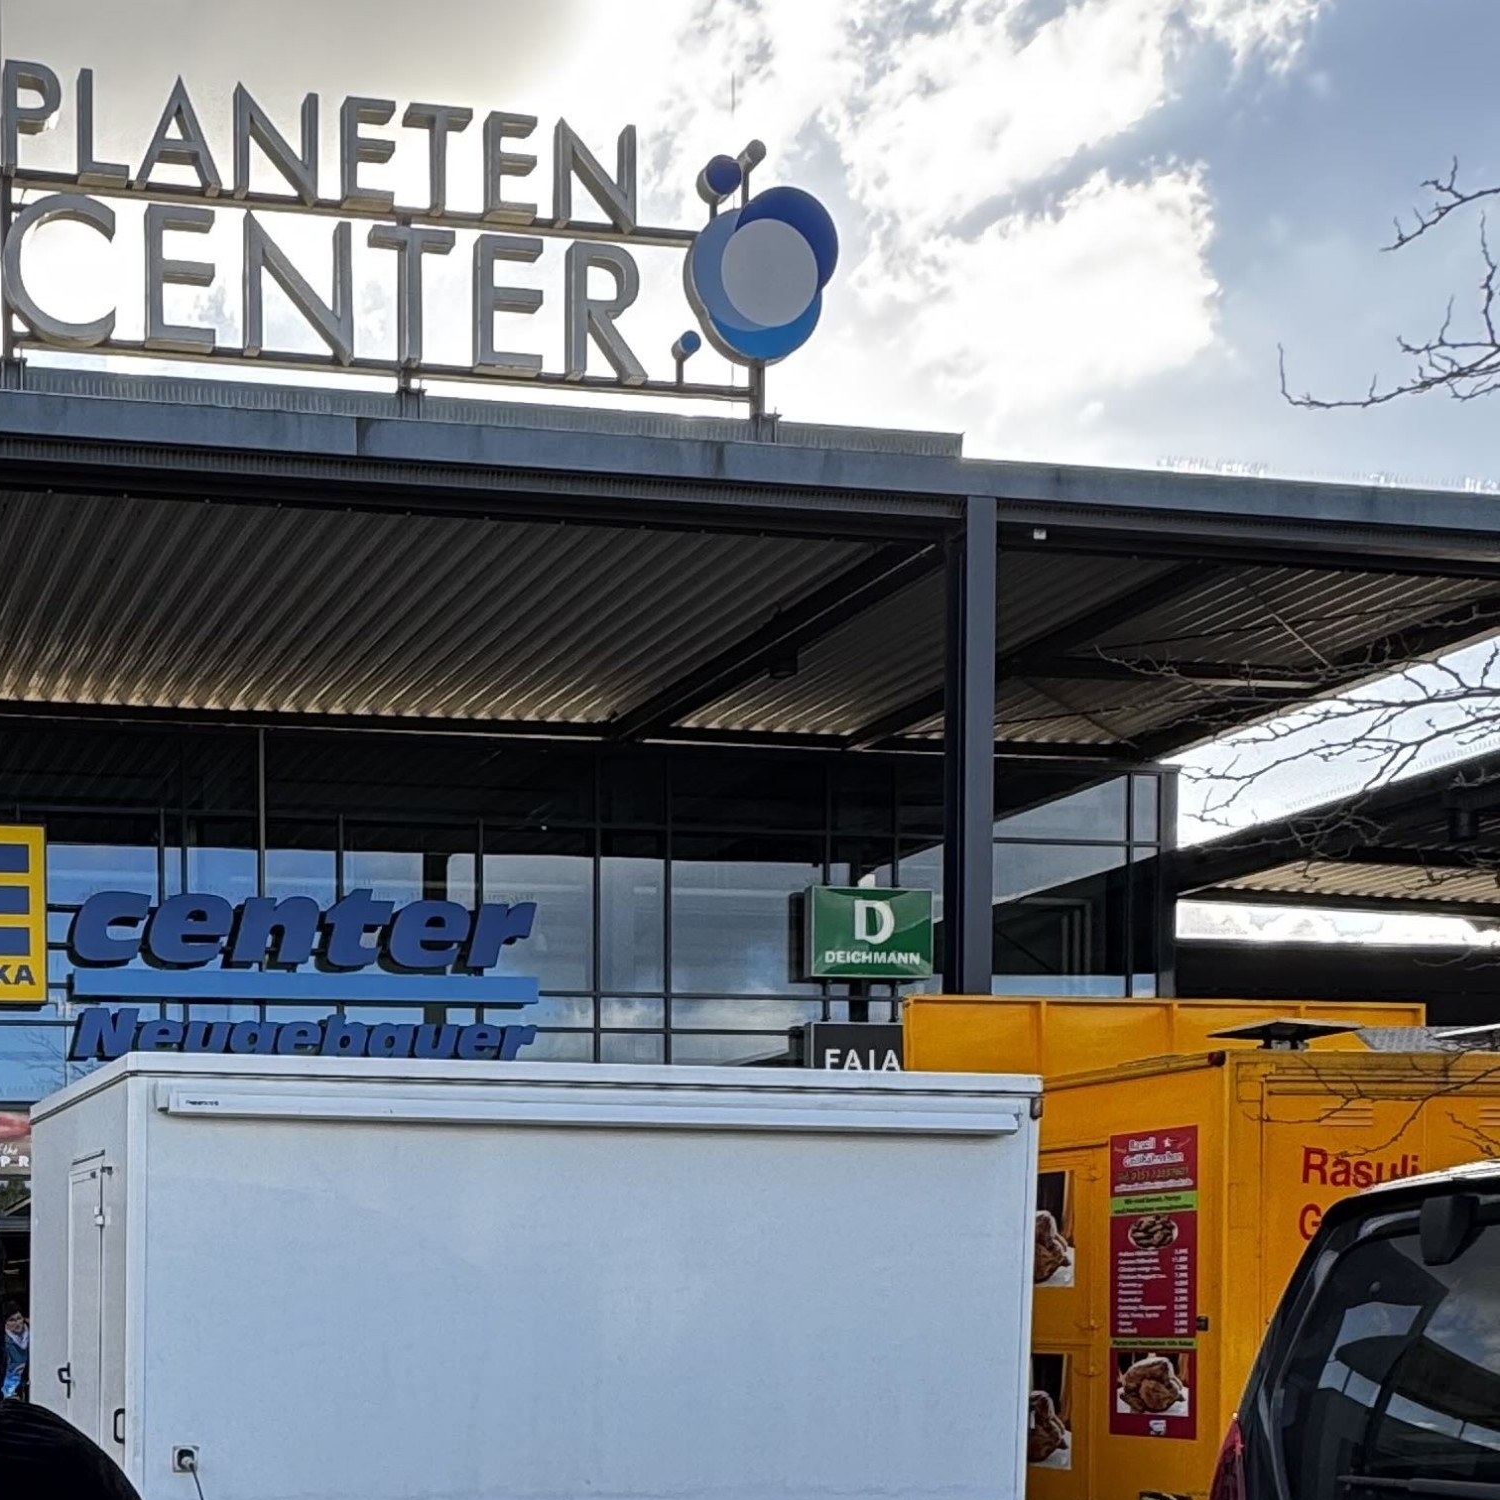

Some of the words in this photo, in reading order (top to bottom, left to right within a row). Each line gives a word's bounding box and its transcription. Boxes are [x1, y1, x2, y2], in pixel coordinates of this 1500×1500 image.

[0, 59, 638, 235] PLANETEN
[2, 193, 649, 386] CENTER
[71, 888, 538, 969] center
[854, 899, 895, 945] D
[824, 950, 921, 965] DEICHMANN
[1301, 1147, 1419, 1189] Rasuli
